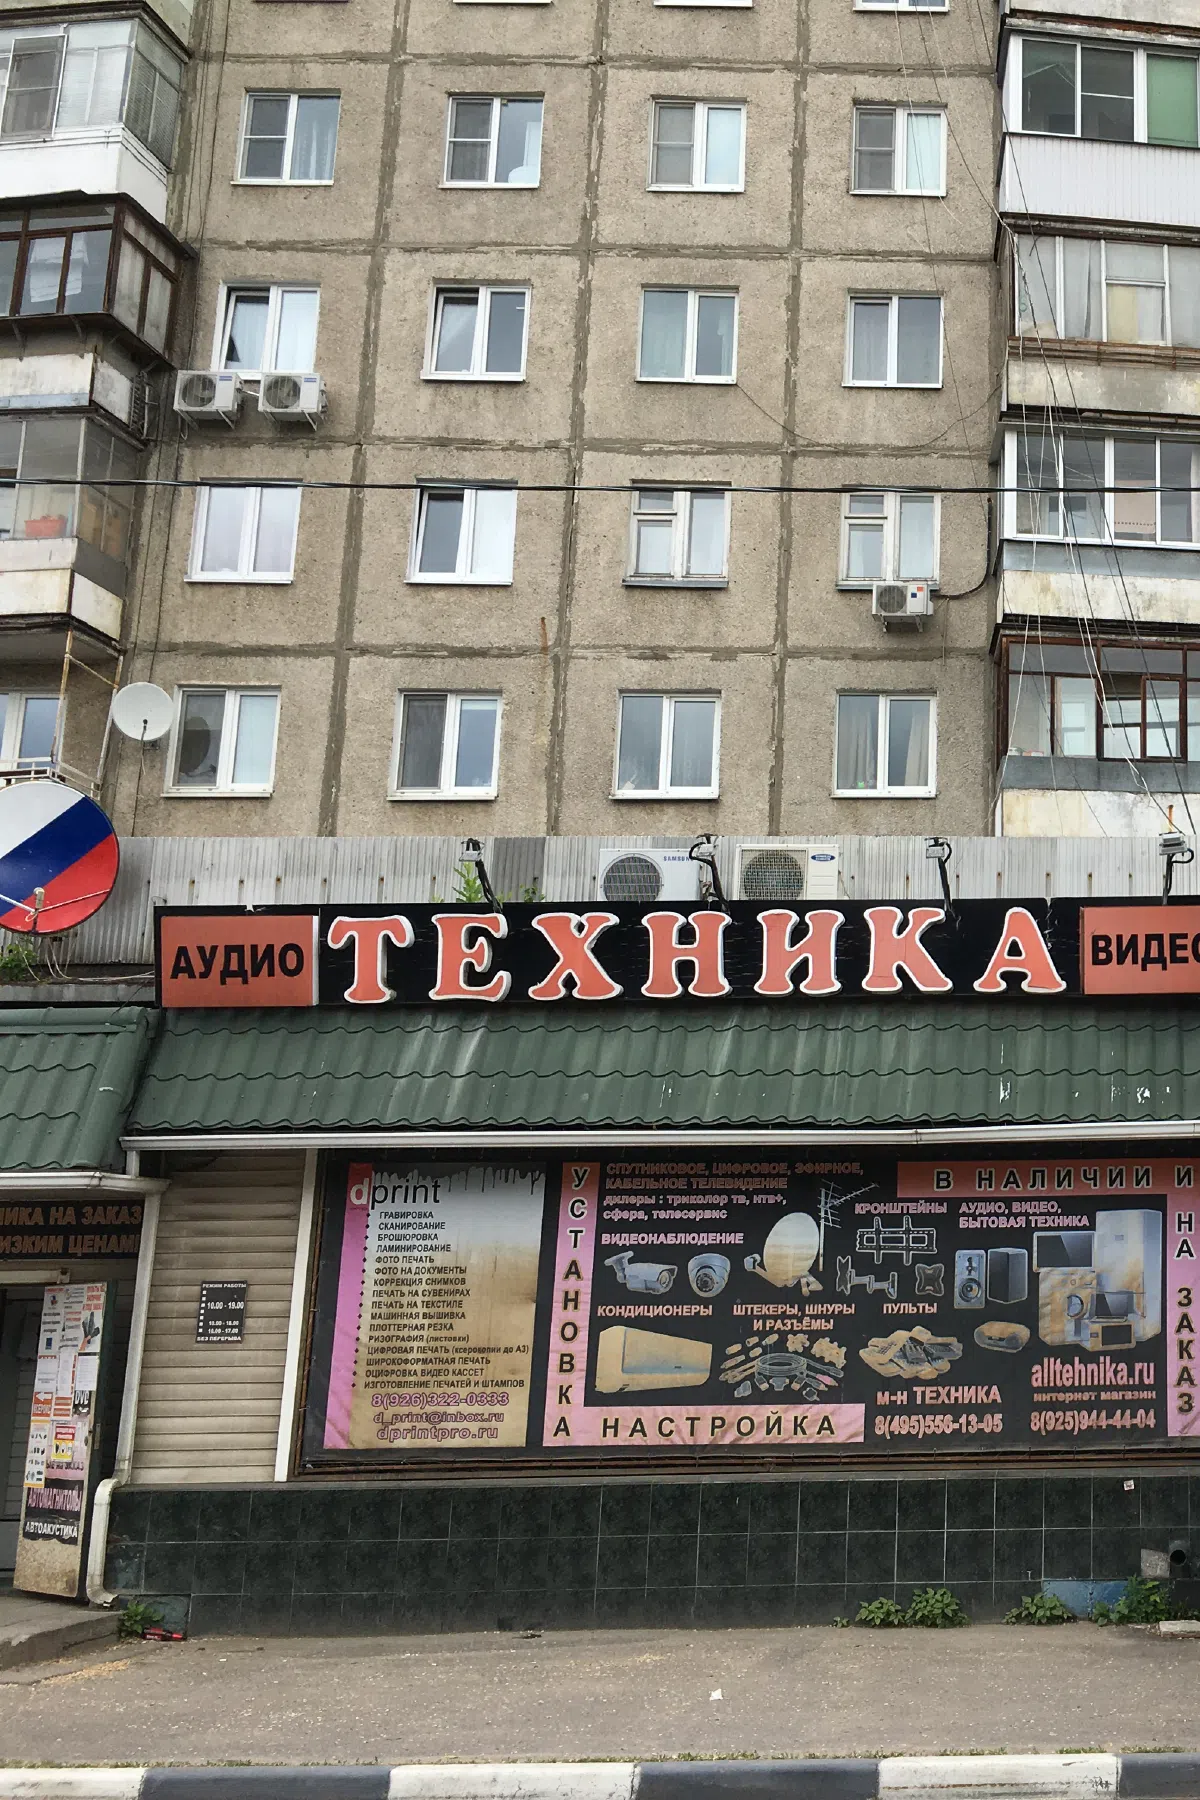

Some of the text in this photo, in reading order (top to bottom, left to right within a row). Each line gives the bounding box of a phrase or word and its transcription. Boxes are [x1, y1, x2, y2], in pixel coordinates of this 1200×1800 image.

[168, 943, 306, 980] АУДИО
[326, 906, 1067, 1005] ТЕХНИКА
[606, 1163, 709, 1175] СПУТНИКОВОЕ,
[713, 1162, 791, 1175] ЦИФРОВОЕ,
[606, 1177, 788, 1190] КАБЕЛЬНОЕ ТЕЛЕВИДЕНИЕ
[933, 1168, 953, 1191] В
[974, 1166, 1153, 1191] НАЛИЧИИ
[350, 1177, 441, 1211] dprint
[666, 1194, 728, 1206] триколор
[854, 1200, 948, 1215] КРОНШТЕЙНЫ
[959, 1201, 1062, 1215] АУДИО, ВИДЕО,
[49, 1207, 76, 1225] НА
[81, 1206, 142, 1225] ЗАКАЗ
[379, 1211, 434, 1219] ГРАВИРОВКА
[652, 1209, 728, 1221] телесервис
[959, 1215, 1090, 1228] БЫТОВАЯ ТЕХНИКА
[378, 1222, 446, 1230] СКАНИРОВАНИЕ
[377, 1233, 439, 1242] БРОШЮРОВКА
[601, 1232, 745, 1246] ВИДЕОНАБЛЮДЕНИЕ
[376, 1244, 451, 1253] ЛАМИНИРОВАНИЕ
[375, 1256, 435, 1264] ФОТО ПЕЧАТЬ
[374, 1266, 467, 1275] ФОТО НА ДОКУМЕНТЫ
[373, 1277, 466, 1287] КОРРЕКЦИЯ СНИМКОВ
[372, 1289, 471, 1298] ПЕЧАТЬ НА СУВЕНИРАХ
[207, 1301, 223, 1309] 10.00
[228, 1301, 244, 1309] 19.00
[371, 1300, 463, 1309] ПЕЧАТЬ НА ТЕКСТИЛЕ
[552, 1165, 590, 1439] УСТАНОВКА
[882, 1303, 938, 1314] ПУЛЬТЫ
[370, 1312, 466, 1320] МАШИННАЯ ВЫШИВКА
[597, 1305, 713, 1318] КОНДИЦИОНЕРЫ
[732, 1303, 855, 1318] ШТЕКЕРЫ, ШНУРЫ
[369, 1323, 454, 1331] ПЛОТТЕРНАЯ РЕЗКА
[753, 1317, 834, 1331] И РАЗЪЁМЫ
[368, 1334, 424, 1343] РИЗОГРАФИЯ
[367, 1346, 414, 1355] ЦИФРОВАЯ
[416, 1346, 450, 1354] ПЕЧАТЬ
[366, 1357, 491, 1366] ШИРОКОФОРМАТНАЯ ПЕЧАТЬ
[365, 1368, 484, 1379] ОЦИФРОВКА ВИДЕО КАССЕТ
[1031, 1356, 1155, 1388] alltehnika.ru
[364, 1380, 431, 1389] ИЗГОТОВЛЕНИЕ
[433, 1378, 472, 1388] ПЕЧАТЕЙ
[481, 1380, 525, 1388] ШТАМПОВ
[371, 1392, 509, 1409] 8(926)322-0333
[913, 1385, 1002, 1405] ТЕХНИКА
[1033, 1390, 1156, 1403] интернет магазин
[373, 1411, 505, 1425] d_print@inbox.ru
[601, 1410, 836, 1438] НАСТРОЙКА
[1030, 1408, 1156, 1436] 8(925)944-44-04
[874, 1413, 1003, 1439] 8(495)556-13-05
[377, 1426, 499, 1442] dprintpro.ru
[25, 1522, 78, 1538] АВТОАКУСТИКА
